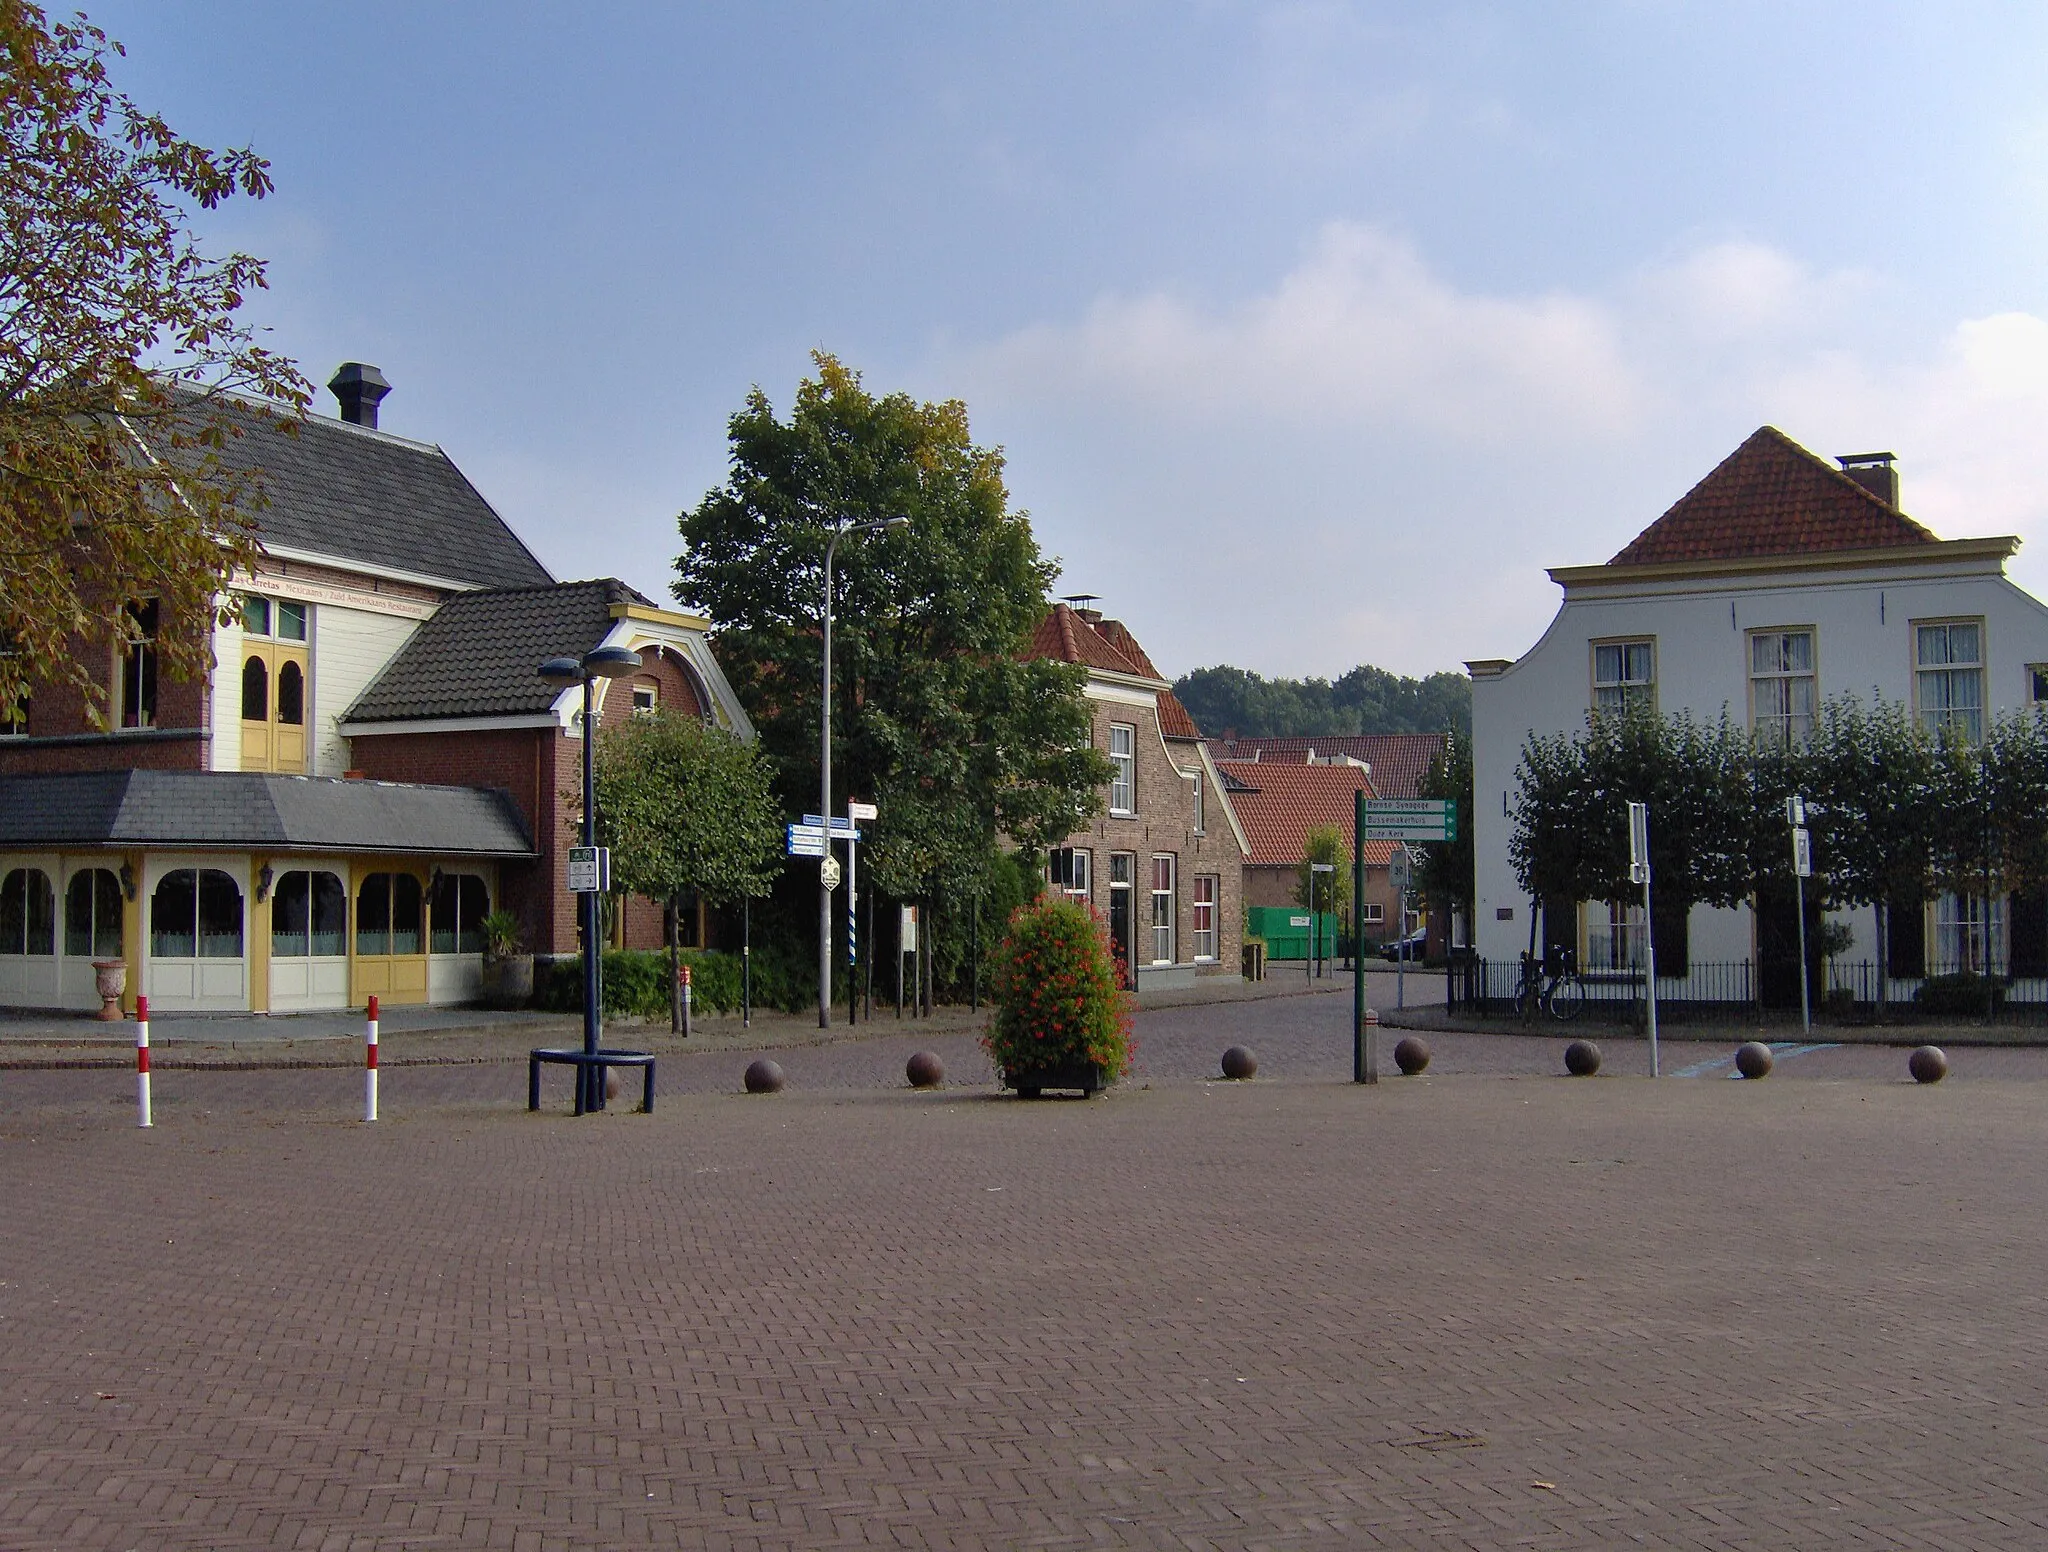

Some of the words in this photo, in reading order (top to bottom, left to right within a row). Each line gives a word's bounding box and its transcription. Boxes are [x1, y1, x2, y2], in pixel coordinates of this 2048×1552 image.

[285, 583, 323, 597] Mexicaans
[330, 591, 345, 601] Zuid
[348, 594, 386, 608] Amerikaans
[388, 601, 422, 614] Restaurant
[1367, 801, 1392, 809] Bornse
[1396, 801, 1429, 811] Synagoge
[1367, 816, 1426, 824] Bussemakerhuis
[1367, 830, 1385, 838] Oude
[1388, 830, 1404, 838] Kerk
